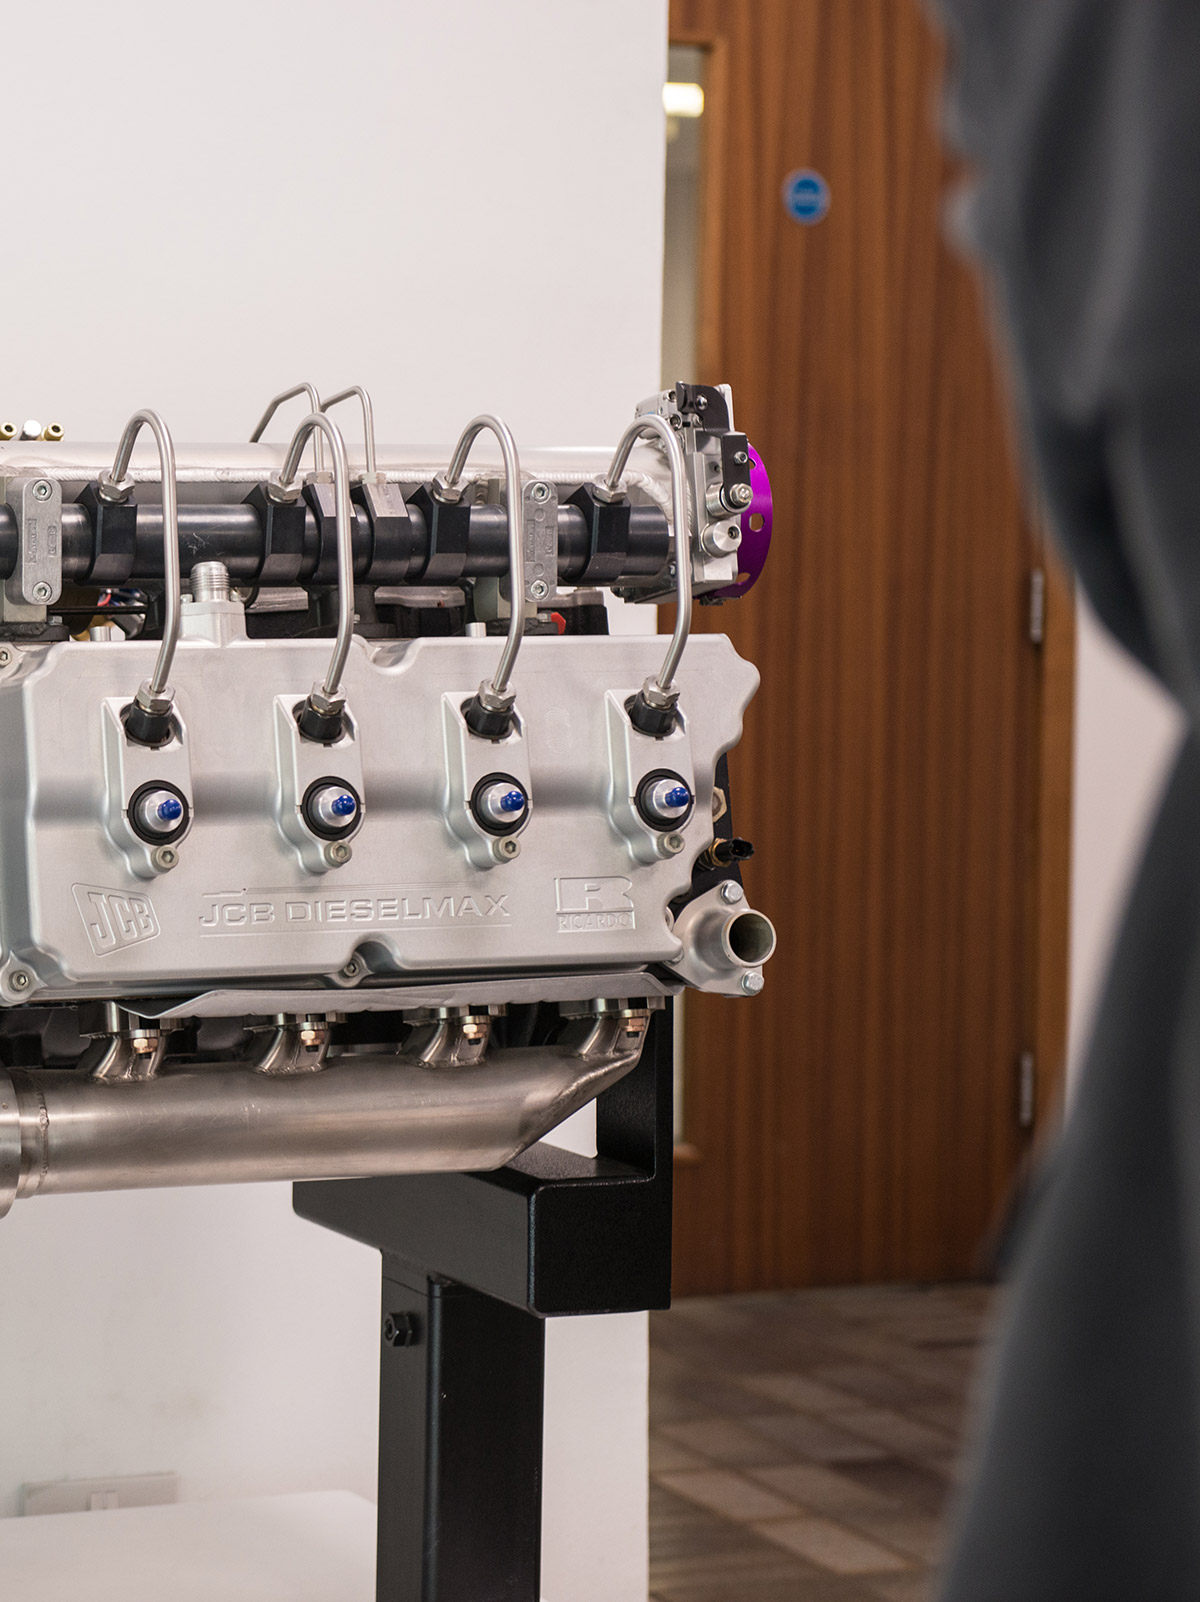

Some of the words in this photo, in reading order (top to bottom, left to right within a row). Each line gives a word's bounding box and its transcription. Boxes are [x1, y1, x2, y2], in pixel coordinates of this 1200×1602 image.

[85, 890, 155, 949] JCB
[199, 902, 275, 927] JCB
[285, 895, 511, 924] DIESELMAX
[557, 912, 633, 930] RICARDO
